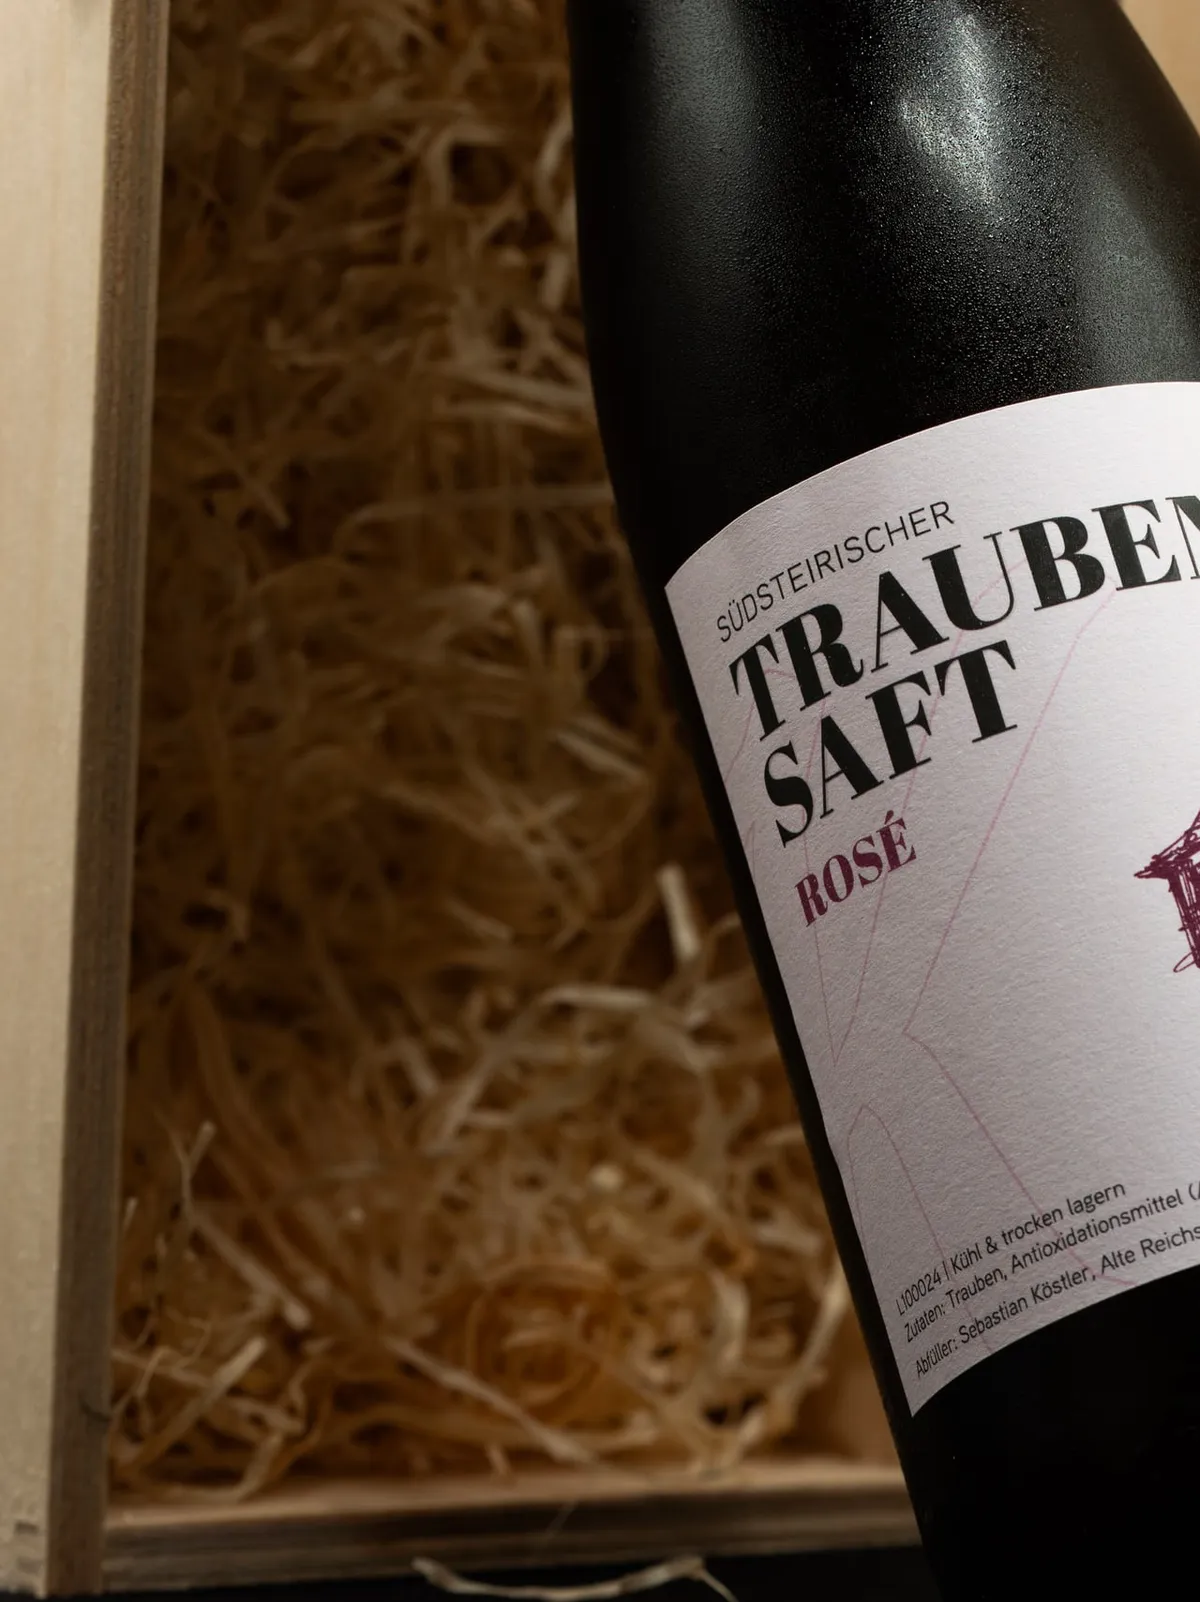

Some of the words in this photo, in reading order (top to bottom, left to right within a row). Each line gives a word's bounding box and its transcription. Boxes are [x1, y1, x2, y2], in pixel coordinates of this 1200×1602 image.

[716, 500, 955, 644] SÜDSTEIRISCHER
[762, 640, 1018, 848] SAFT
[794, 810, 917, 927] ROSÉ
[904, 1303, 945, 1343] Zutaten:
[945, 1267, 1008, 1308] Trauben,
[1011, 1188, 1184, 1275] Antioxidationsmittel
[950, 1243, 983, 1274] Kühl
[985, 1236, 998, 1254] &
[1002, 1209, 1064, 1248] trocken
[1066, 1183, 1126, 1215] lagern
[916, 1338, 958, 1378] Abfüller:
[958, 1297, 1029, 1344] Sebastian
[1030, 1266, 1097, 1305] Köstler,
[1100, 1250, 1137, 1275] Alte
